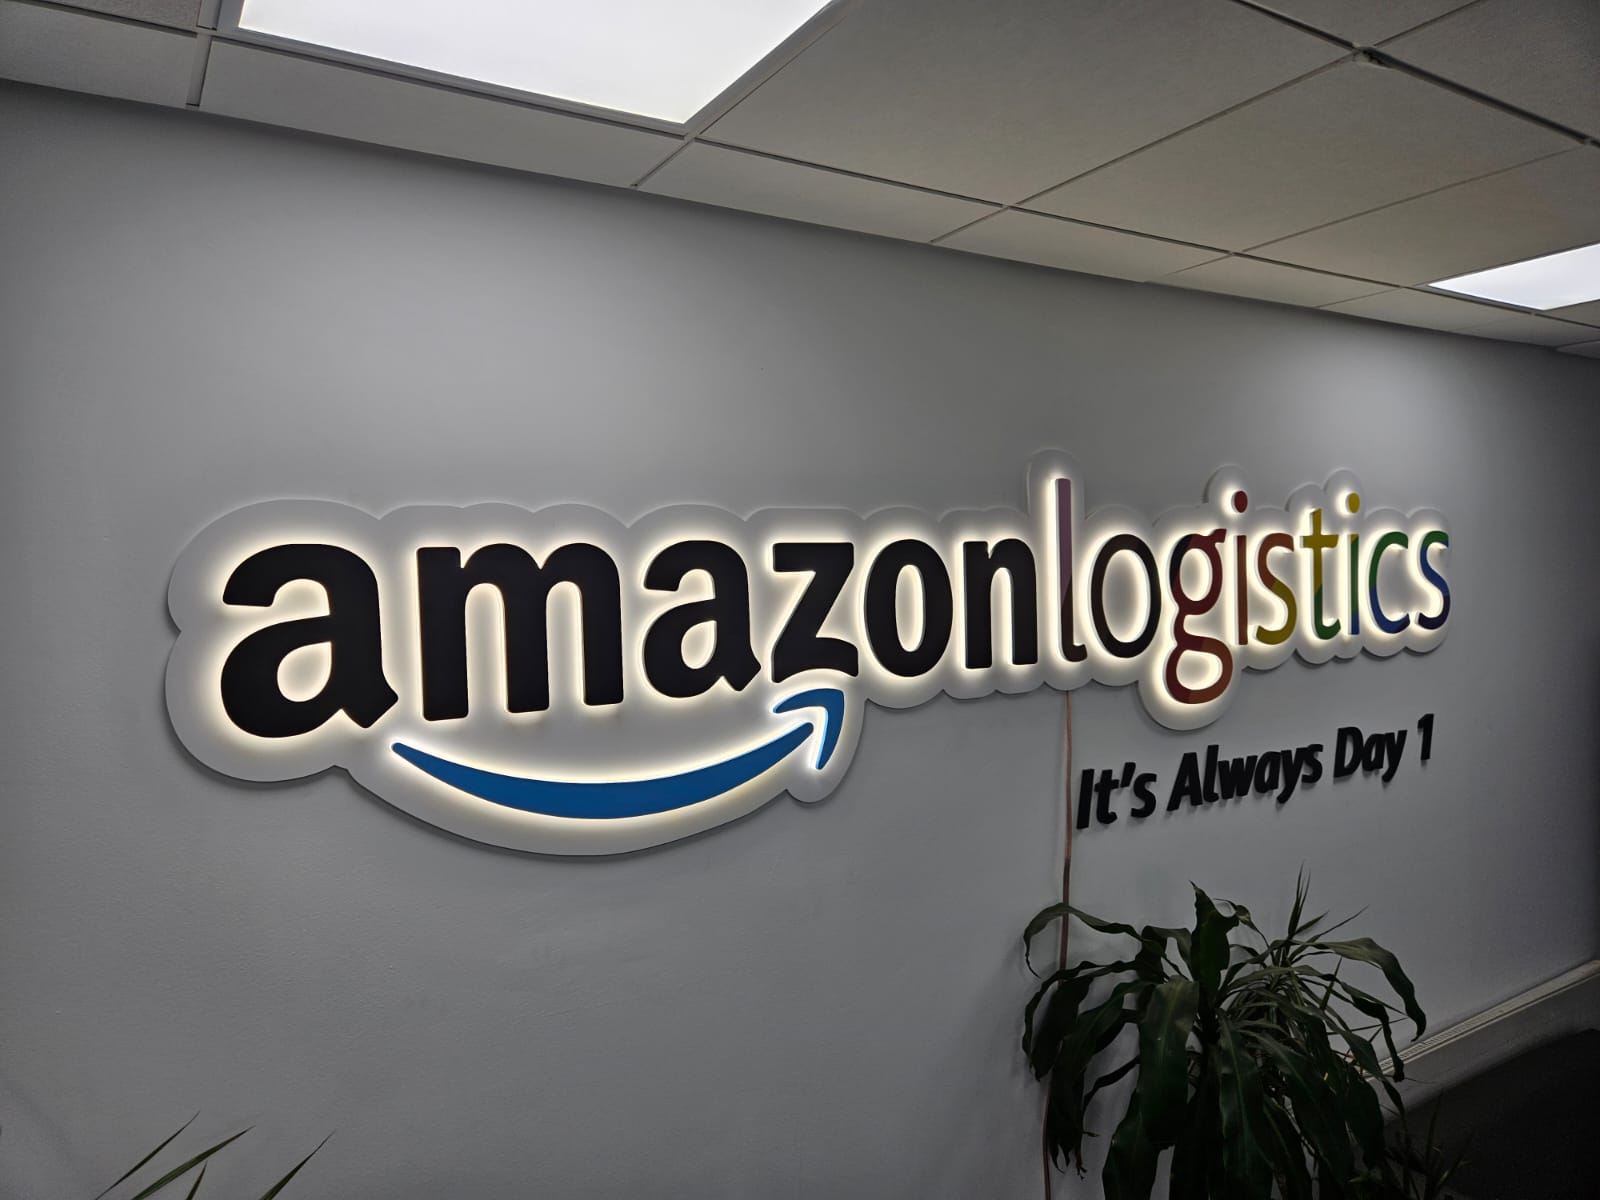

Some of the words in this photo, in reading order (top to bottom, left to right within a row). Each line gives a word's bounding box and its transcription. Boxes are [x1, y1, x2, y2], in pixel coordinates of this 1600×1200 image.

[1076, 762, 1157, 829] It's
[1166, 743, 1324, 811] Always
[1333, 726, 1408, 783] Day
[1417, 713, 1434, 760] 1
